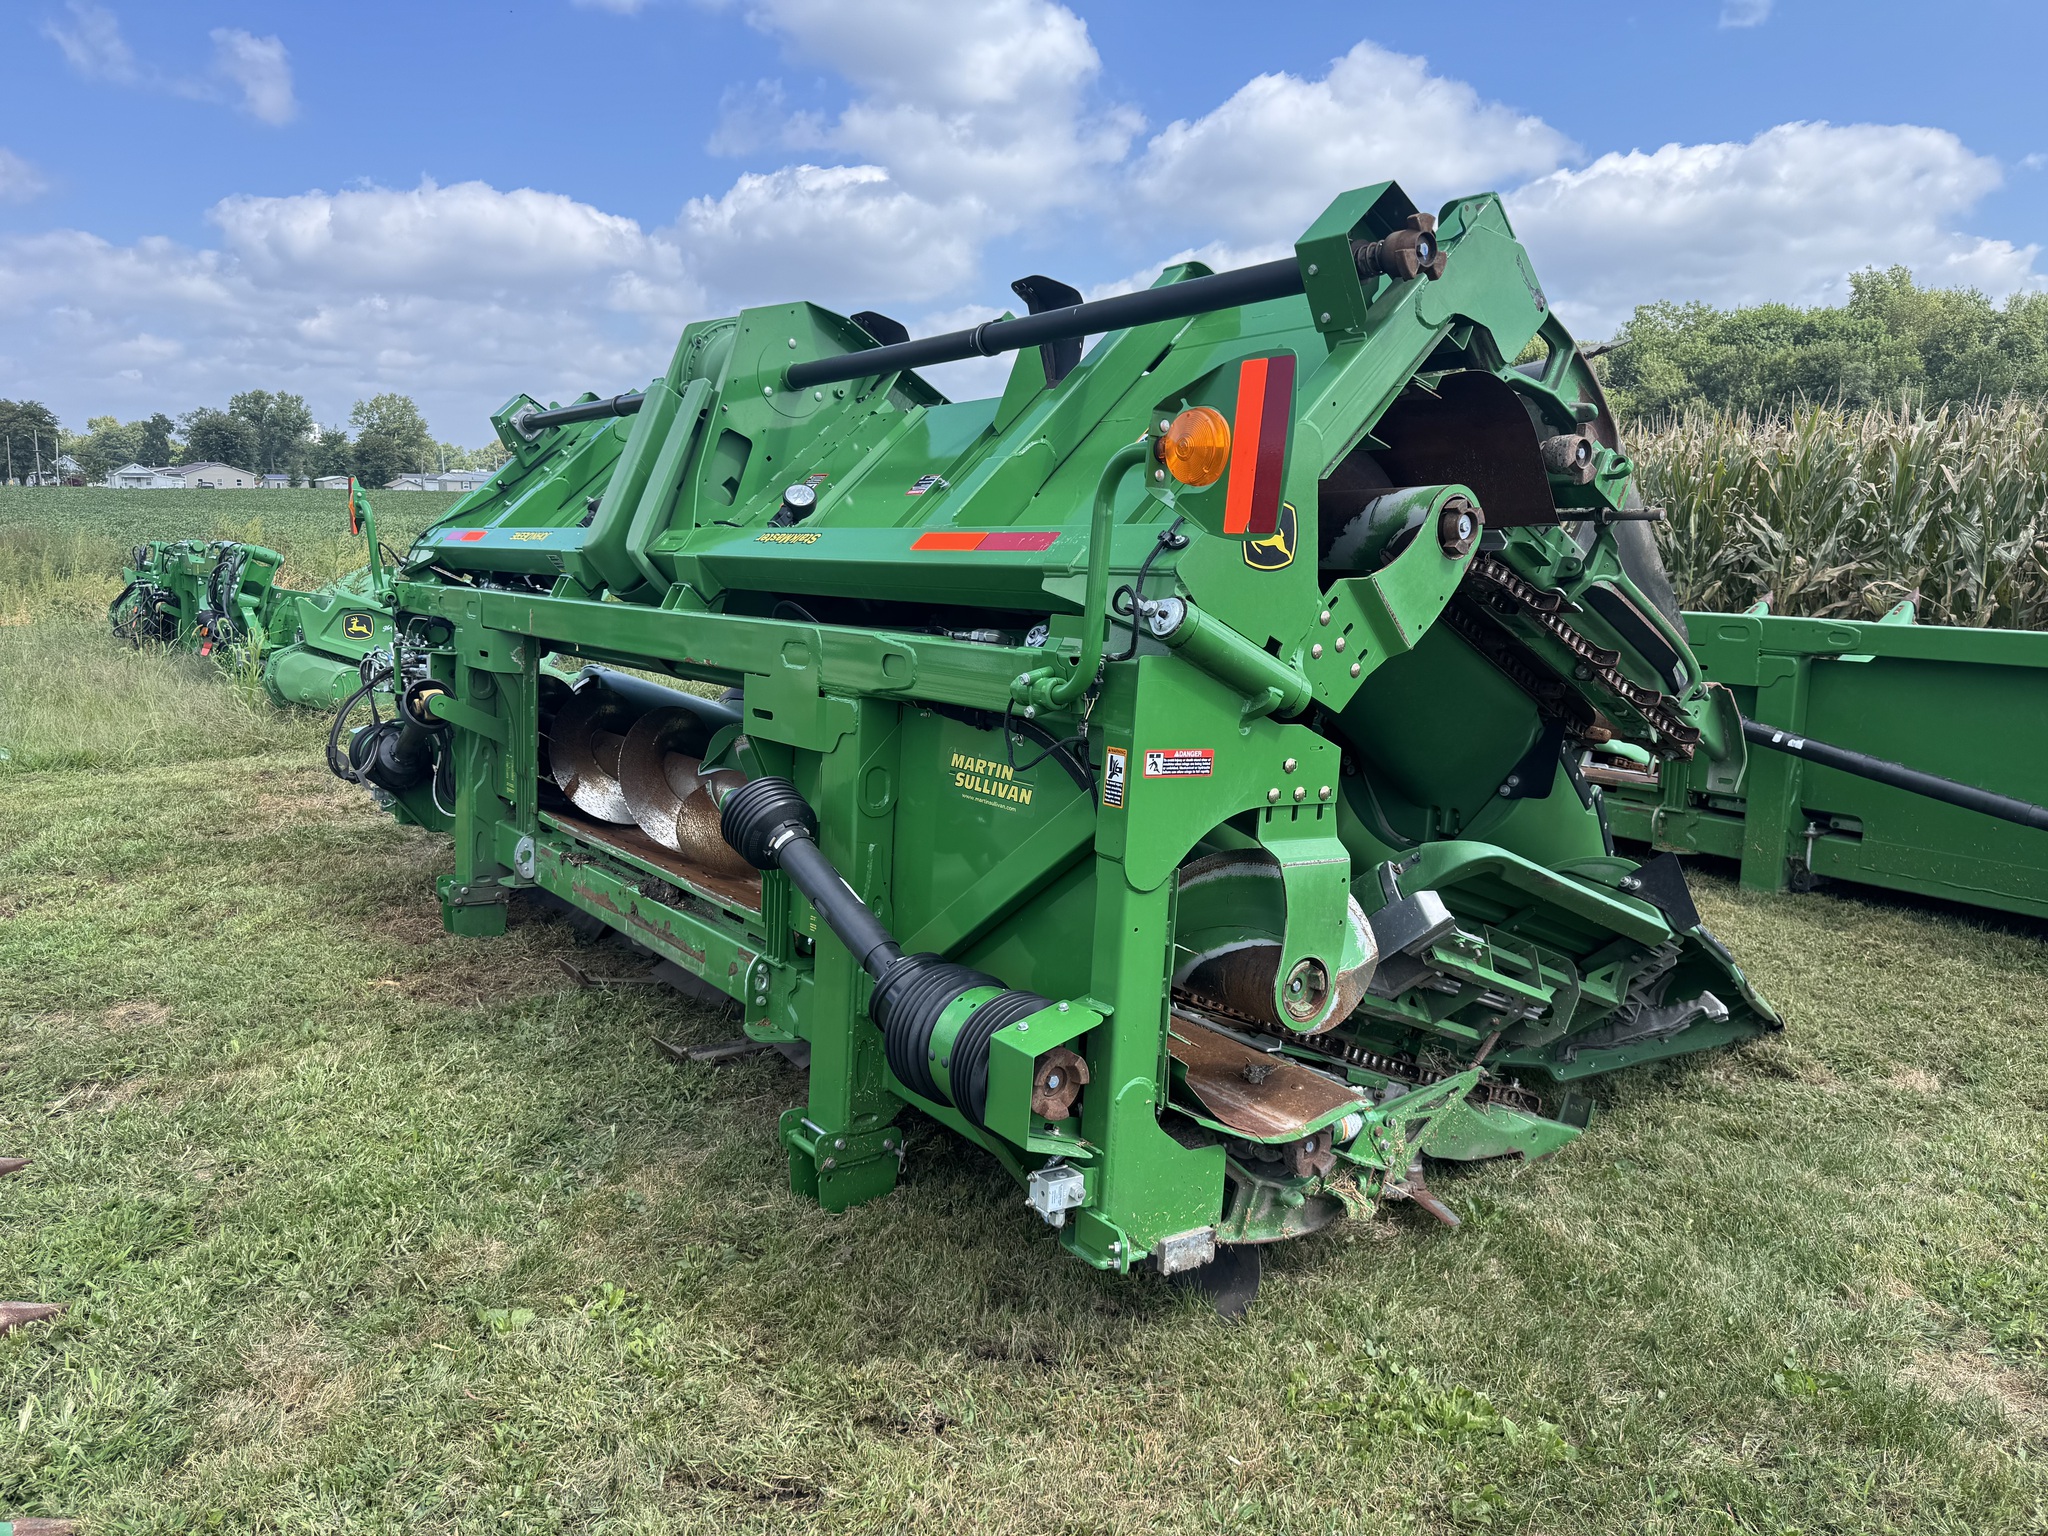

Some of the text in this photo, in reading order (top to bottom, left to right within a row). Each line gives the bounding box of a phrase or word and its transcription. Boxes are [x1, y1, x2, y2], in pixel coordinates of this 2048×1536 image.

[755, 533, 822, 545] StalkMaster
[1179, 750, 1203, 758] DANGER
[951, 753, 1014, 781] MARTIN
[954, 772, 1033, 805] SULLIVAN
[962, 793, 1017, 812] www.martinsullivan.com
